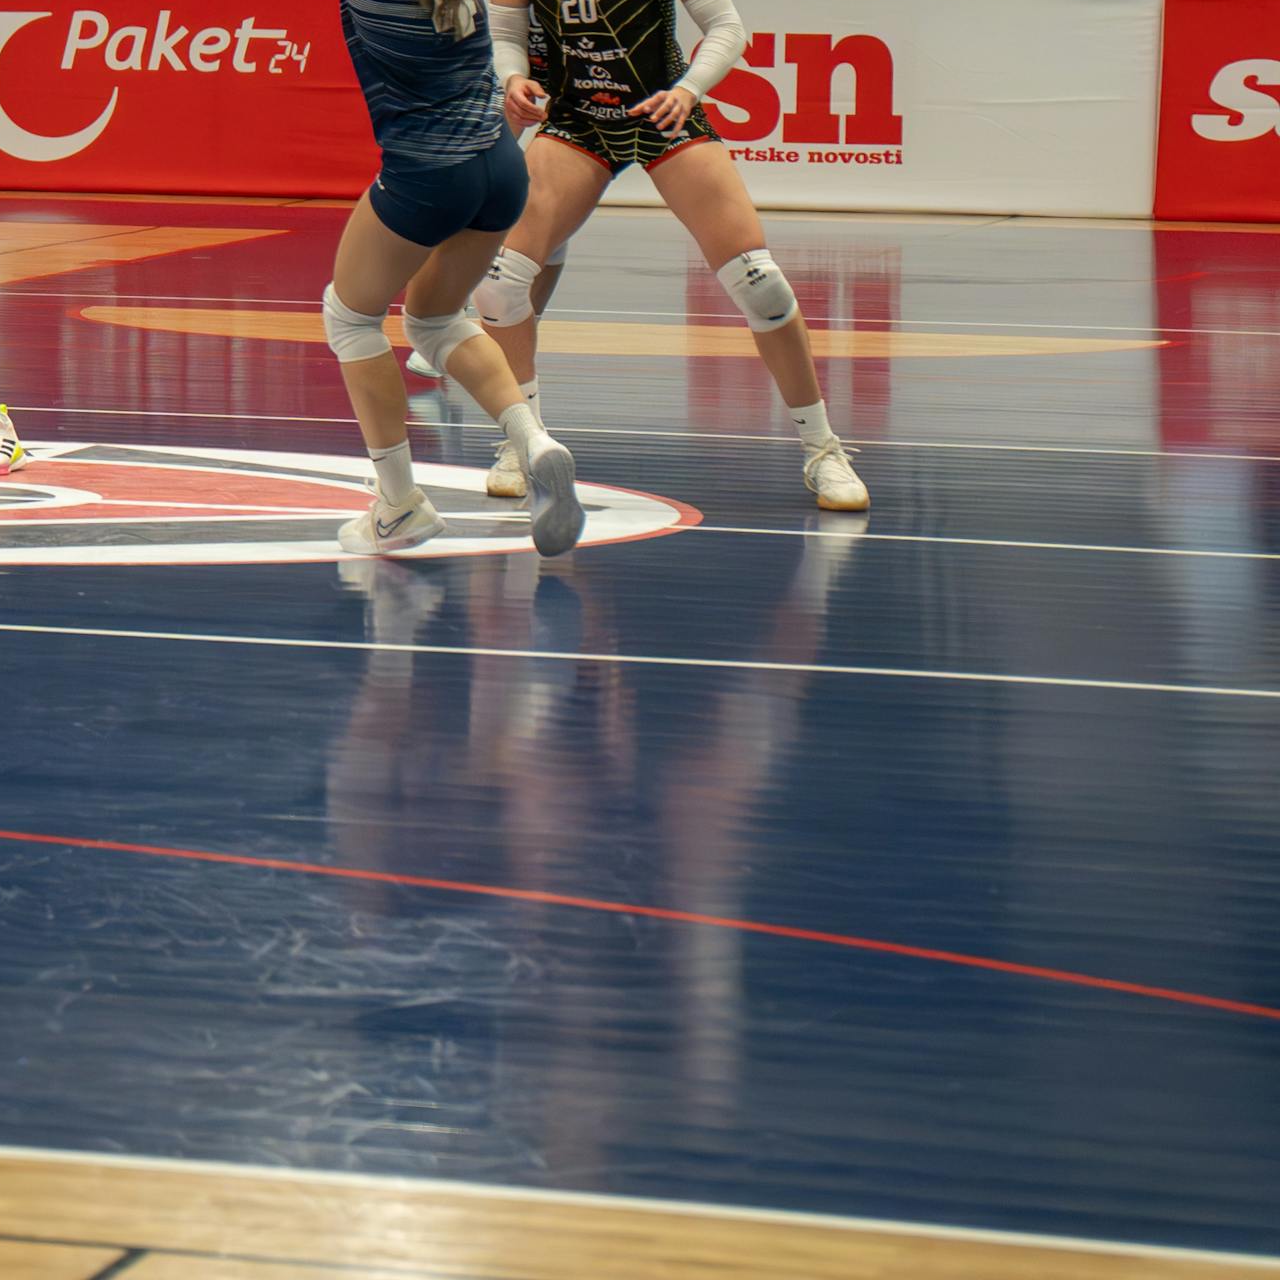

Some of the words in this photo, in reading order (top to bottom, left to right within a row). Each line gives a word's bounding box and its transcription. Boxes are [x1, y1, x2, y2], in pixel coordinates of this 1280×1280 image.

[561, 44, 629, 62] FAVBET
[728, 146, 800, 163] rtske
[807, 148, 903, 165] novosti
